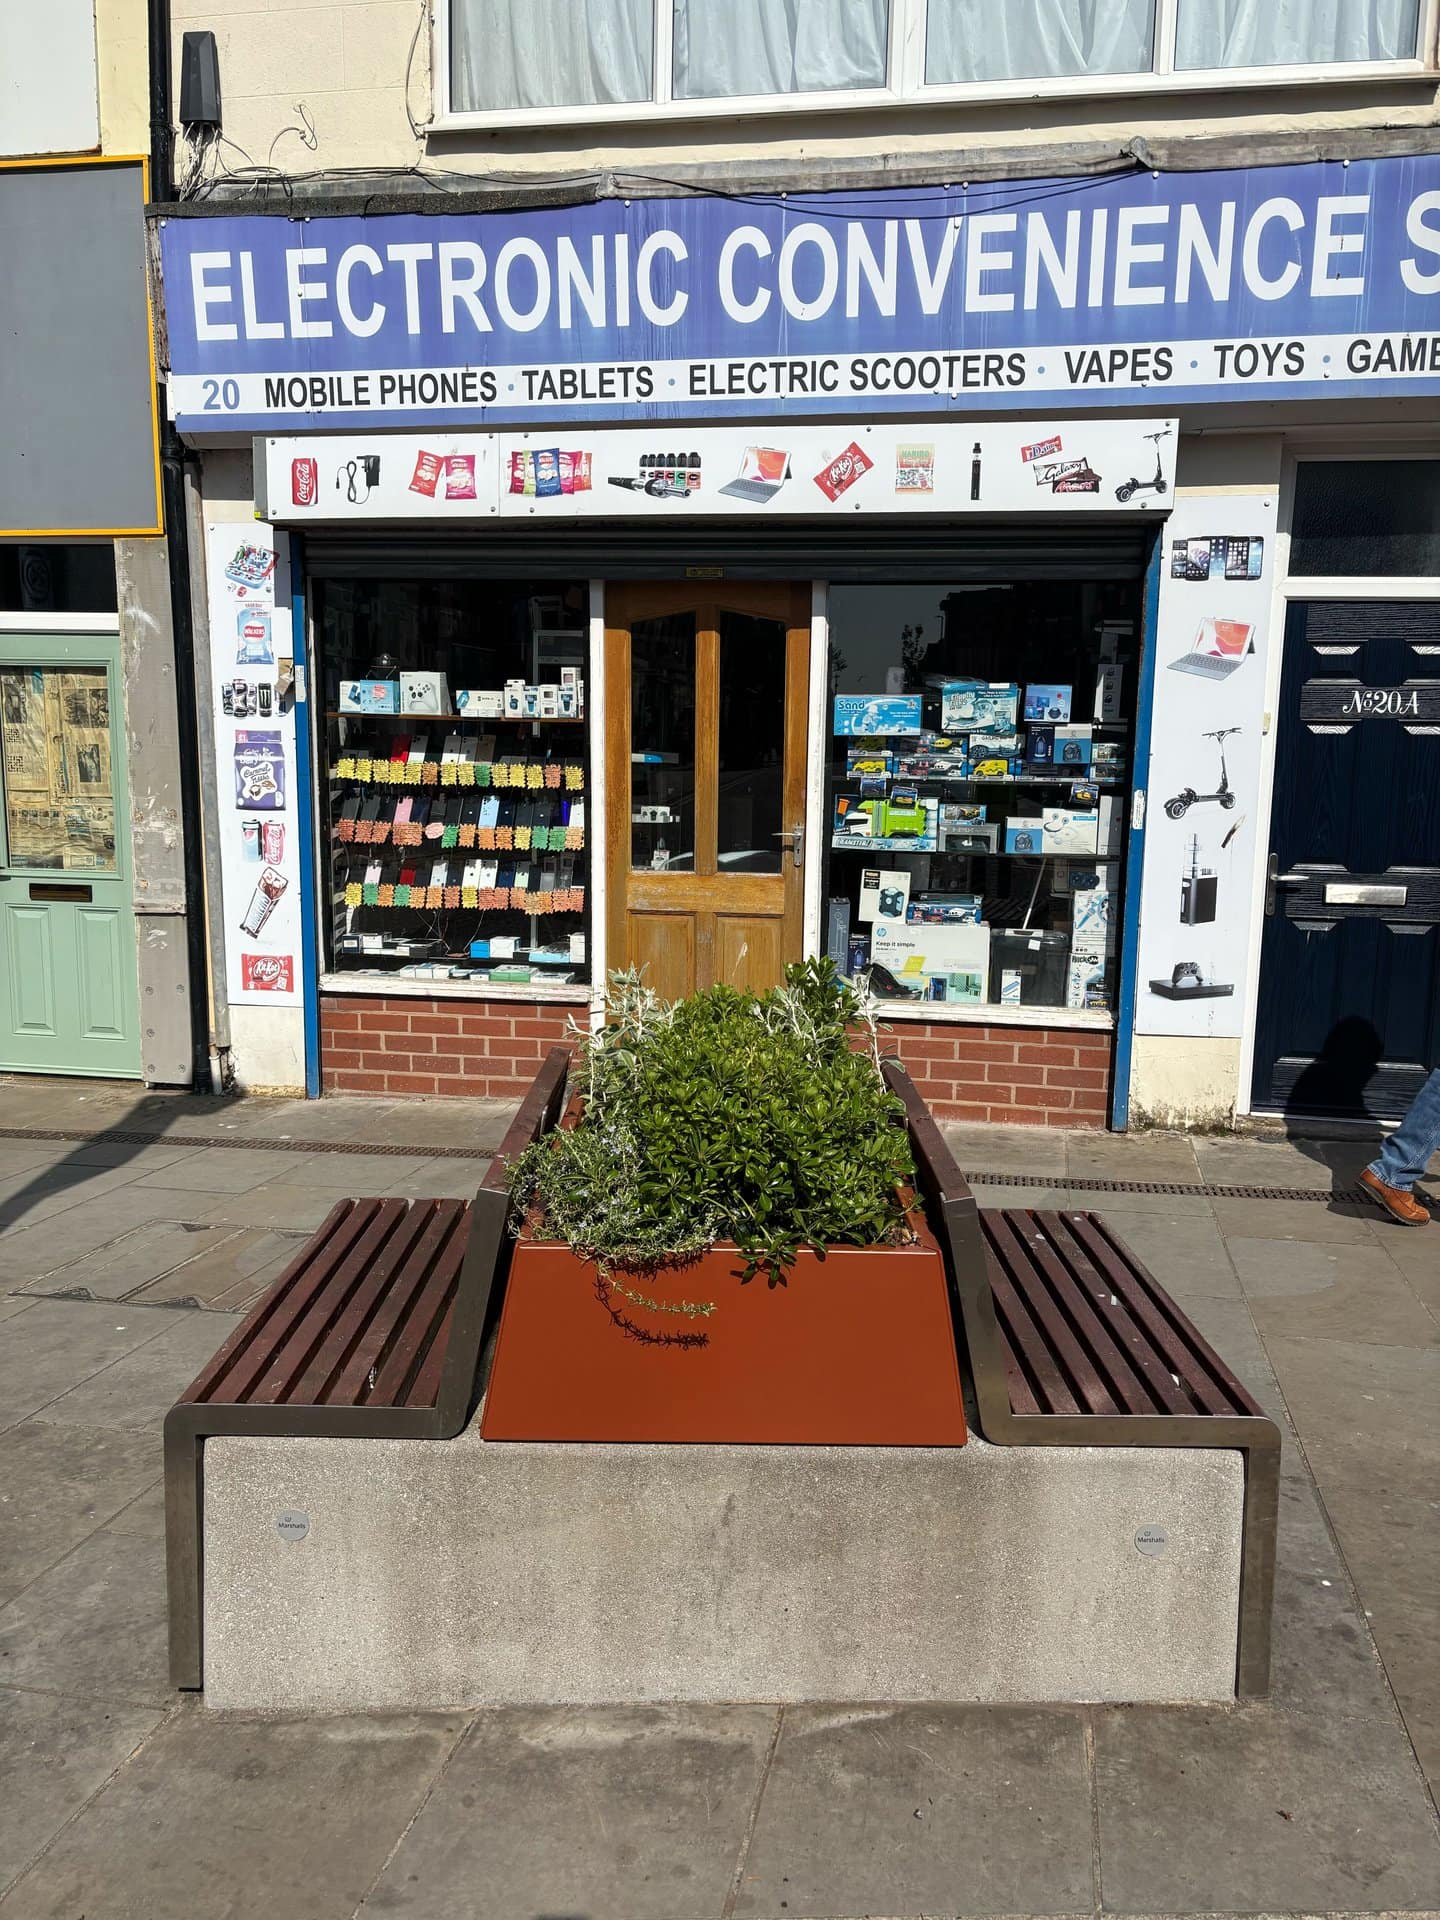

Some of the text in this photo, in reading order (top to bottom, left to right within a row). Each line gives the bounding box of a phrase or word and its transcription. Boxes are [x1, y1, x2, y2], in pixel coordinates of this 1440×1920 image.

[189, 229, 689, 342] ELECTRONIC
[718, 196, 1371, 323] CONVENIENCE
[265, 375, 371, 409] MOBILE
[381, 369, 497, 405] PHONES
[521, 366, 654, 401] TABLETS
[689, 359, 839, 396] ELECTRIC
[849, 353, 1026, 392] SCOOTERS
[1064, 347, 1174, 384] VAPES
[1214, 341, 1305, 379] TOYS
[202, 378, 239, 411] 20
[1044, 462, 1081, 480] Galaxy
[838, 700, 865, 711] Sand
